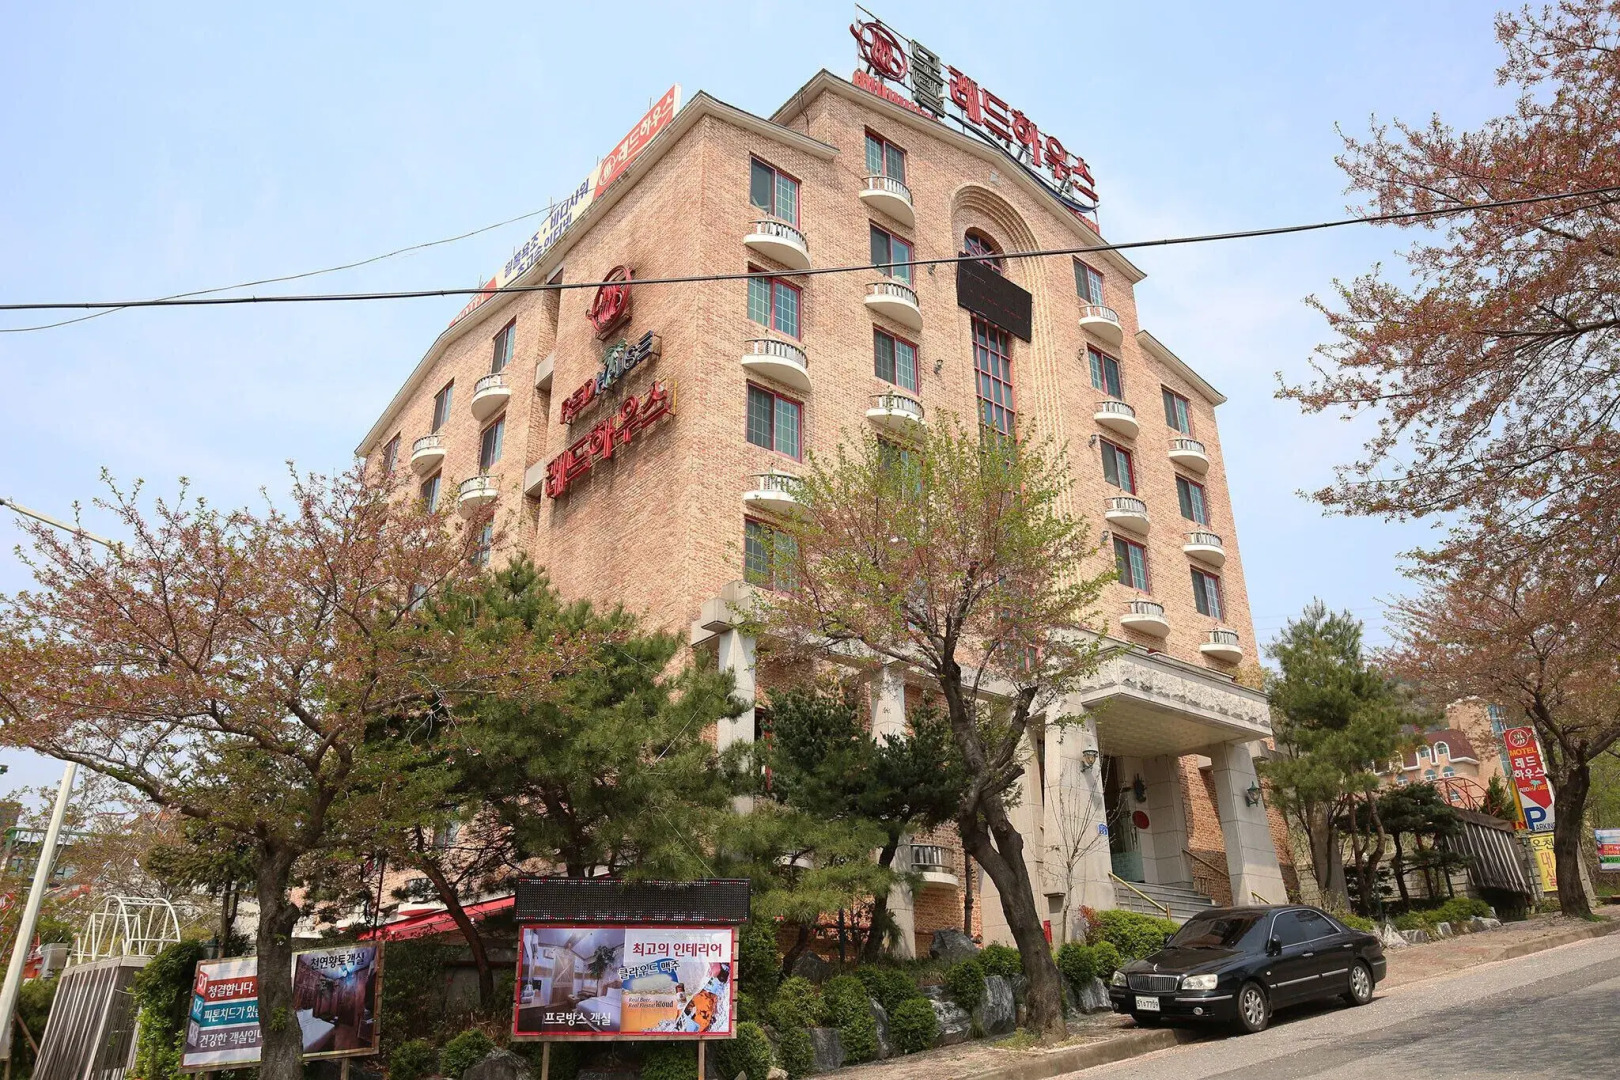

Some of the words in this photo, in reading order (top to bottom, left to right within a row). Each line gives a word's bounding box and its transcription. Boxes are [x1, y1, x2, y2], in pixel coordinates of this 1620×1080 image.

[618, 95, 674, 160] 레드하우스
[948, 65, 1099, 202] 레드하우스
[550, 178, 590, 231] 바디샤워
[545, 380, 670, 498] 레드하우스
[1509, 747, 1538, 757] MOTEL
[1514, 756, 1537, 769] 레드
[1513, 768, 1545, 780] 하우스
[632, 943, 669, 957] 최고의
[673, 943, 722, 957] 인테리어
[618, 962, 659, 980] 클라우드
[660, 960, 680, 972] 맥주
[198, 973, 208, 990] 01
[208, 981, 255, 998] 청결합니다.
[193, 998, 204, 1016] 02
[204, 1006, 246, 1023] 피톤치드가
[544, 1012, 587, 1025] 프로방스
[589, 1012, 612, 1026] 객실
[199, 1032, 227, 1048] 건강한
